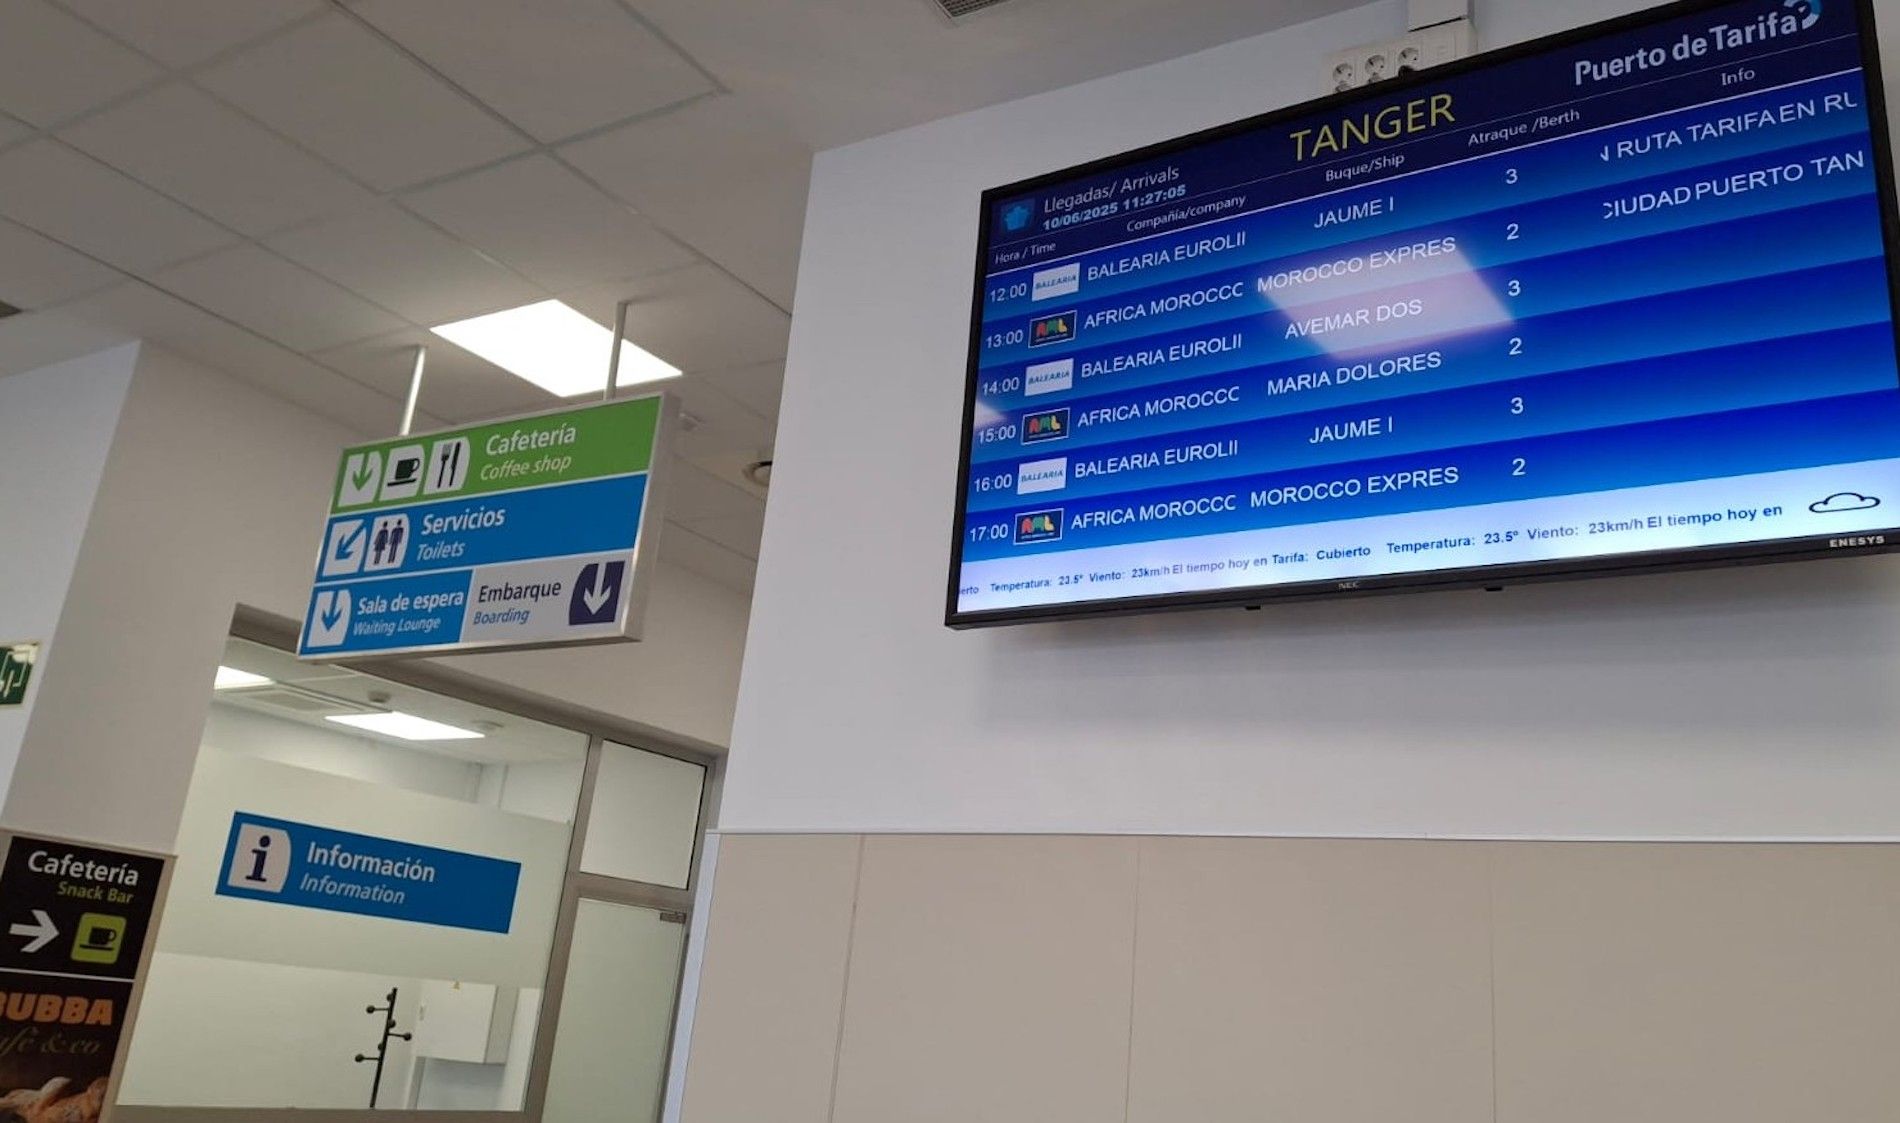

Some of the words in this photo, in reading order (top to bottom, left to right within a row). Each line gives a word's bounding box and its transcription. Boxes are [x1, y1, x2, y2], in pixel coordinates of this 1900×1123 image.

[1574, 46, 1666, 85] Puerto
[1672, 34, 1708, 61] de
[1709, 12, 1797, 51] Tarifa
[1720, 68, 1755, 86] Info
[1290, 93, 1455, 162] TANGER
[1468, 123, 1527, 147] Atraque
[1532, 109, 1580, 133] /Berth
[1617, 131, 1682, 158] RUTA
[1687, 109, 1776, 142] TARIFA
[1780, 99, 1815, 122] EN
[1325, 154, 1405, 182] Buque/Ship
[1505, 168, 1518, 184] 3
[1695, 163, 1803, 200] PUERTO
[1809, 150, 1864, 176] TAN
[1044, 181, 1117, 213] Llegadas/
[1120, 166, 1180, 195] Arrivals
[1043, 202, 1118, 231] 10/06/2025
[1122, 184, 1186, 212] 11:27:05
[1314, 199, 1382, 228] JAUME
[1389, 196, 1394, 211] I
[1506, 223, 1519, 240] 2
[994, 250, 1020, 264] Hora
[1030, 242, 1056, 256] Time
[1257, 257, 1362, 293] MOROCCO
[1369, 236, 1456, 268] EXPRES
[1087, 252, 1170, 281] BALEARIA
[990, 282, 1027, 303] 12:00
[1508, 280, 1521, 296] 3
[1084, 304, 1147, 329] AFRICA
[1285, 309, 1369, 339] AVEMAR
[1376, 299, 1423, 322] DOS
[985, 328, 1023, 349] 13:00
[1509, 337, 1522, 355] 2
[1081, 350, 1165, 378] BALEARIA
[1267, 371, 1331, 396] MARIA
[1336, 351, 1442, 384] DOLORES
[982, 375, 1019, 396] 14:00
[1077, 404, 1141, 428] AFRICA
[1511, 397, 1524, 414] 3
[485, 422, 577, 456] Cafetería
[978, 424, 1017, 444] 15:00
[1309, 418, 1381, 444] JAUME
[1387, 416, 1393, 432] I
[480, 459, 529, 481] Coffee
[532, 453, 572, 475] shop
[1075, 453, 1160, 479] BALEARIA
[1512, 458, 1526, 476] 2
[974, 473, 1013, 493] 16:00
[1250, 480, 1361, 508] MOROCCO
[1368, 466, 1460, 494] EXPRES
[420, 506, 506, 536] Servicios
[1071, 507, 1136, 530] AFRICA
[970, 523, 1009, 542] 17:00
[1829, 534, 1885, 548] ENESYS
[416, 540, 465, 561] Toilets
[960, 585, 979, 596] erto
[1089, 570, 1125, 583] Viento:
[1131, 566, 1171, 579] 23km/h
[1172, 564, 1183, 575] El
[1187, 561, 1224, 574] tiempo
[1229, 557, 1250, 571] hoy
[1253, 557, 1268, 567] en
[1272, 552, 1308, 566] Tarifa:
[1316, 546, 1371, 561] Cubierto
[1387, 535, 1475, 554] Temperatura:
[1527, 525, 1579, 541] Viento:
[1588, 518, 1643, 535] 23km/h
[1647, 515, 1662, 529] El
[1667, 510, 1722, 527] tiempo
[1727, 507, 1757, 523] hoy
[1763, 505, 1783, 517] en
[357, 594, 388, 616] Sala
[390, 592, 411, 611] de
[412, 590, 464, 614] espera
[478, 579, 562, 604] Embarque
[353, 618, 396, 637] Waiting
[397, 615, 441, 635] Lounge
[473, 607, 530, 626] Boarding
[28, 850, 139, 887] Cafetería
[306, 841, 436, 883] Información
[57, 880, 103, 901] Snack
[107, 887, 134, 904] Bar
[299, 871, 405, 905] Information
